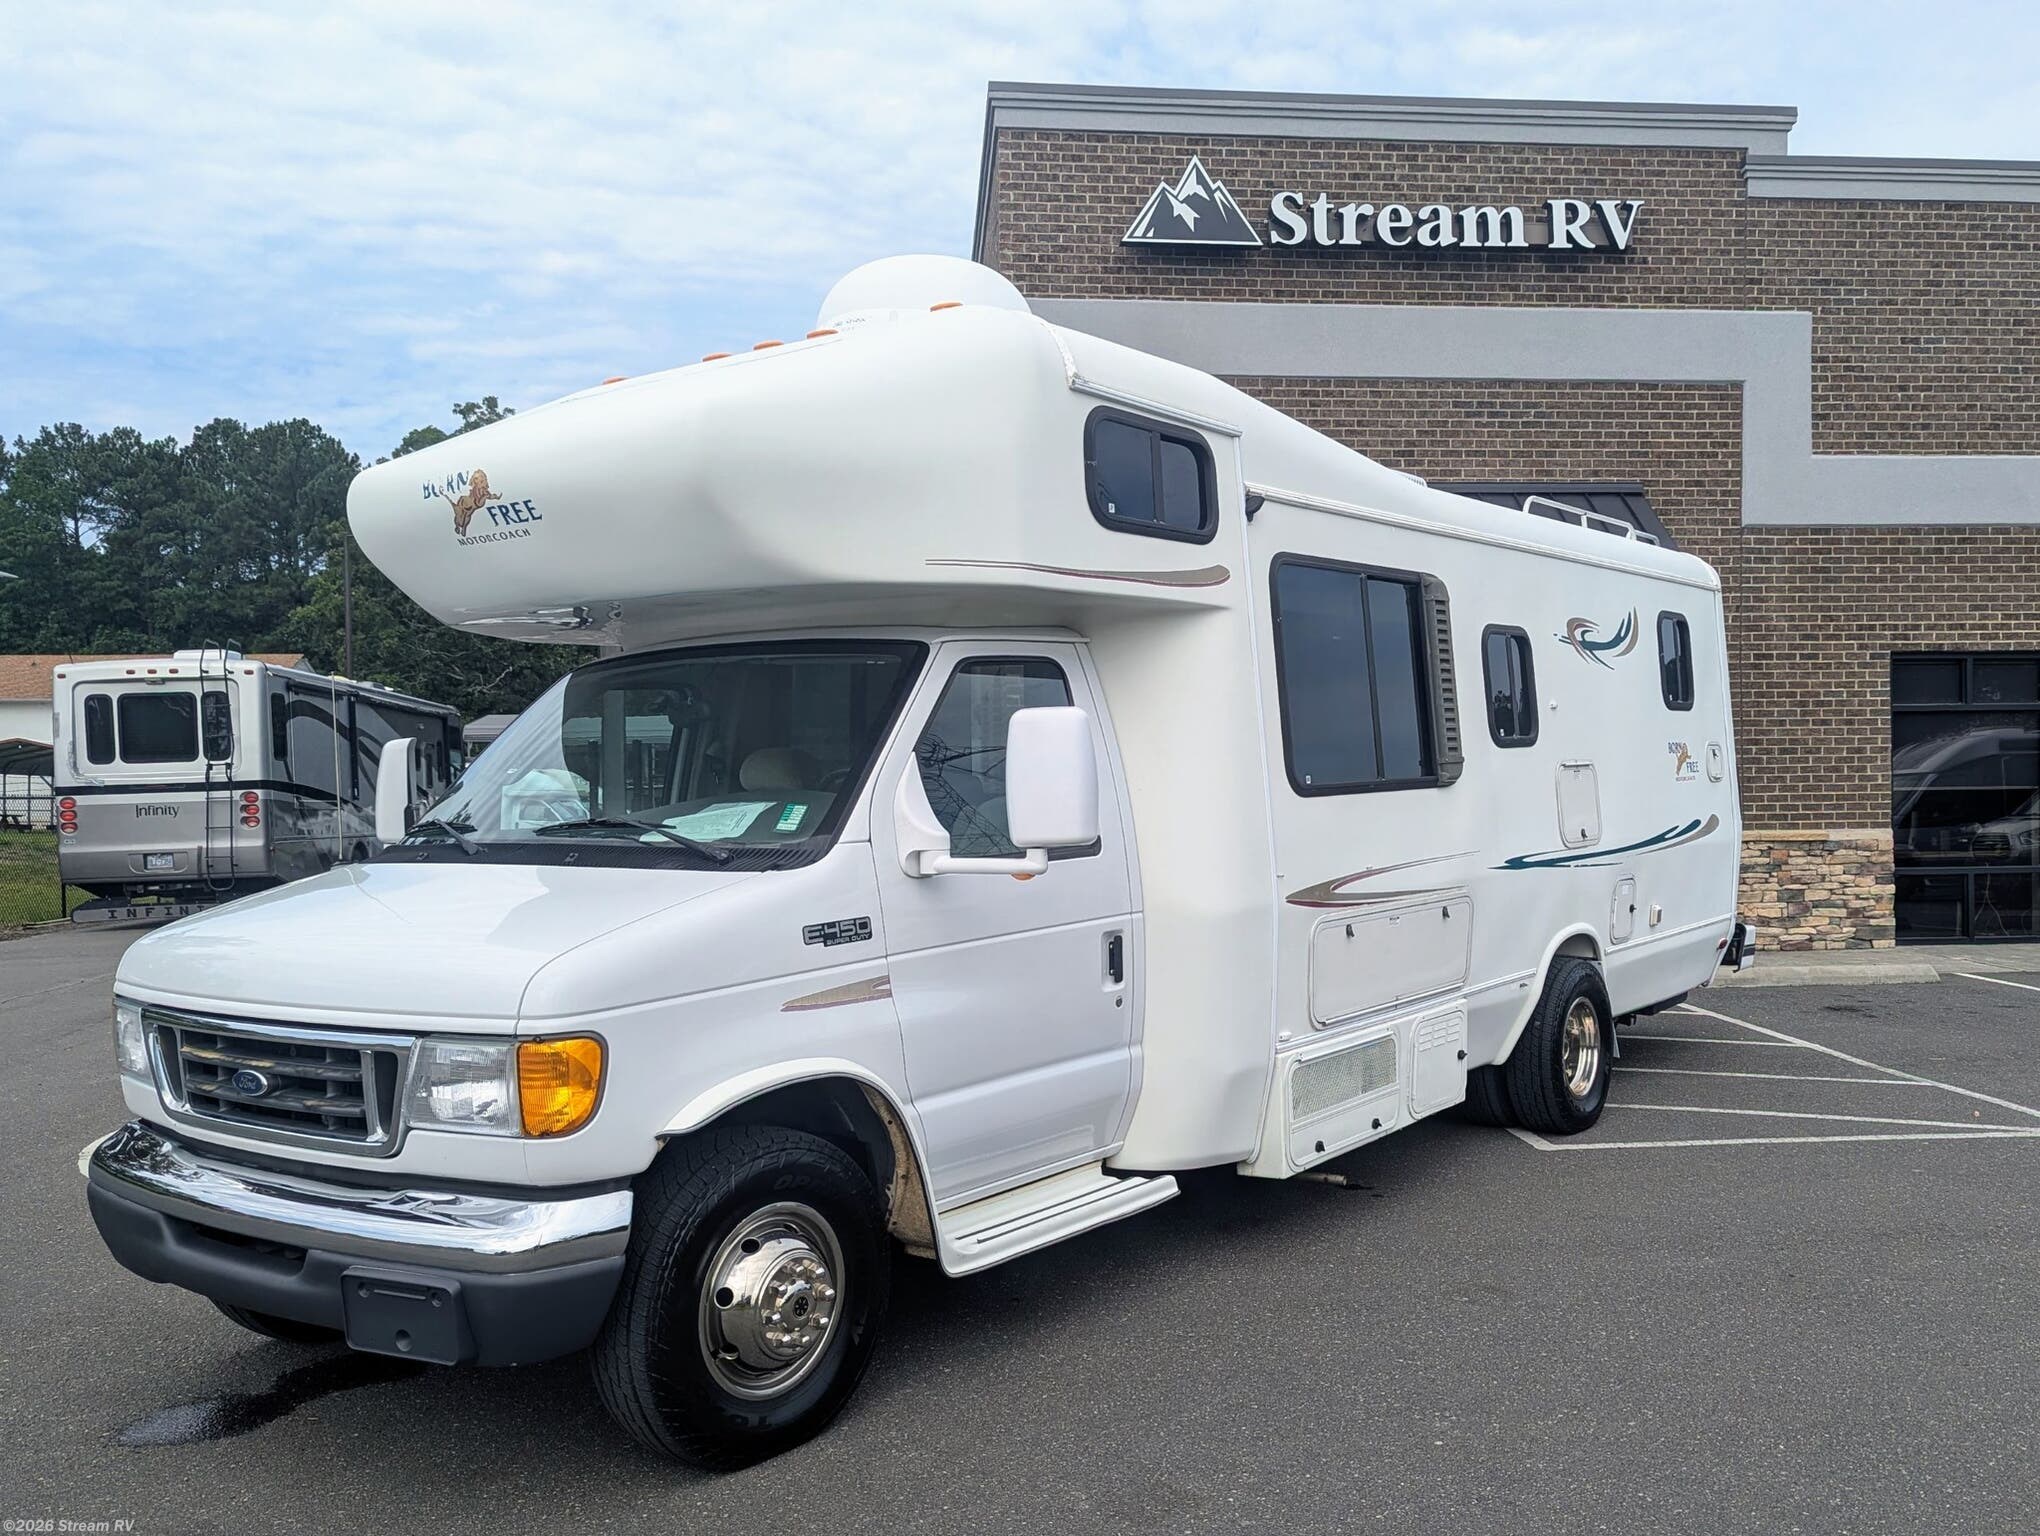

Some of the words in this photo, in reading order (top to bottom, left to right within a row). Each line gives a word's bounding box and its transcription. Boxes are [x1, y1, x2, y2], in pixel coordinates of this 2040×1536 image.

[1270, 191, 1529, 247] Stream
[1547, 199, 1645, 250] RV
[485, 499, 543, 527] FREE
[457, 528, 531, 546] MOTORCOACH
[136, 804, 180, 818] Infinity
[826, 936, 850, 945] SUPER
[851, 933, 870, 941] DUTY
